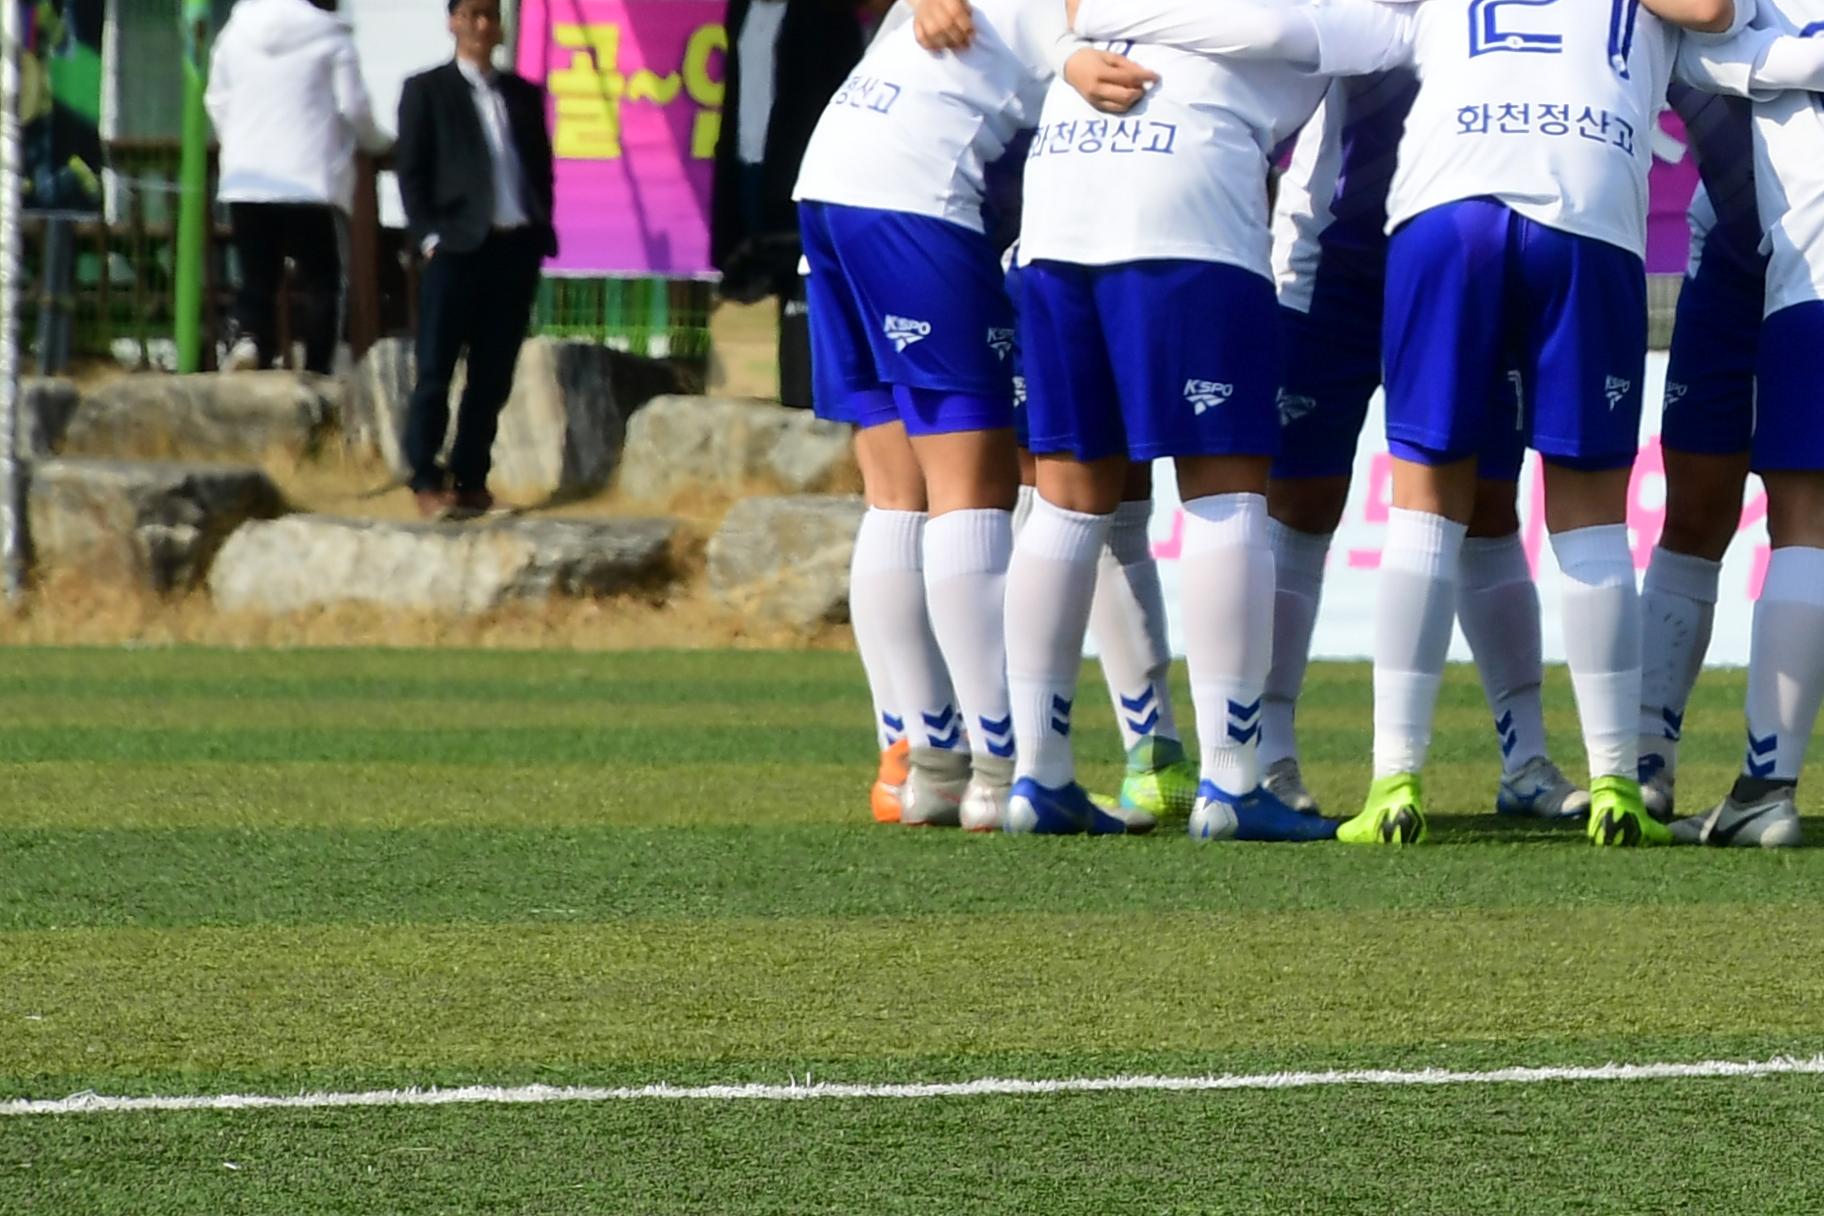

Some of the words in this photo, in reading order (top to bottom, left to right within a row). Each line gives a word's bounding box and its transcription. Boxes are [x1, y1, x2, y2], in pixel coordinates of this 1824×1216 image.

[1456, 102, 1635, 157] 화천정산고
[883, 314, 932, 336] KSPO
[1183, 378, 1234, 397] KSPO
